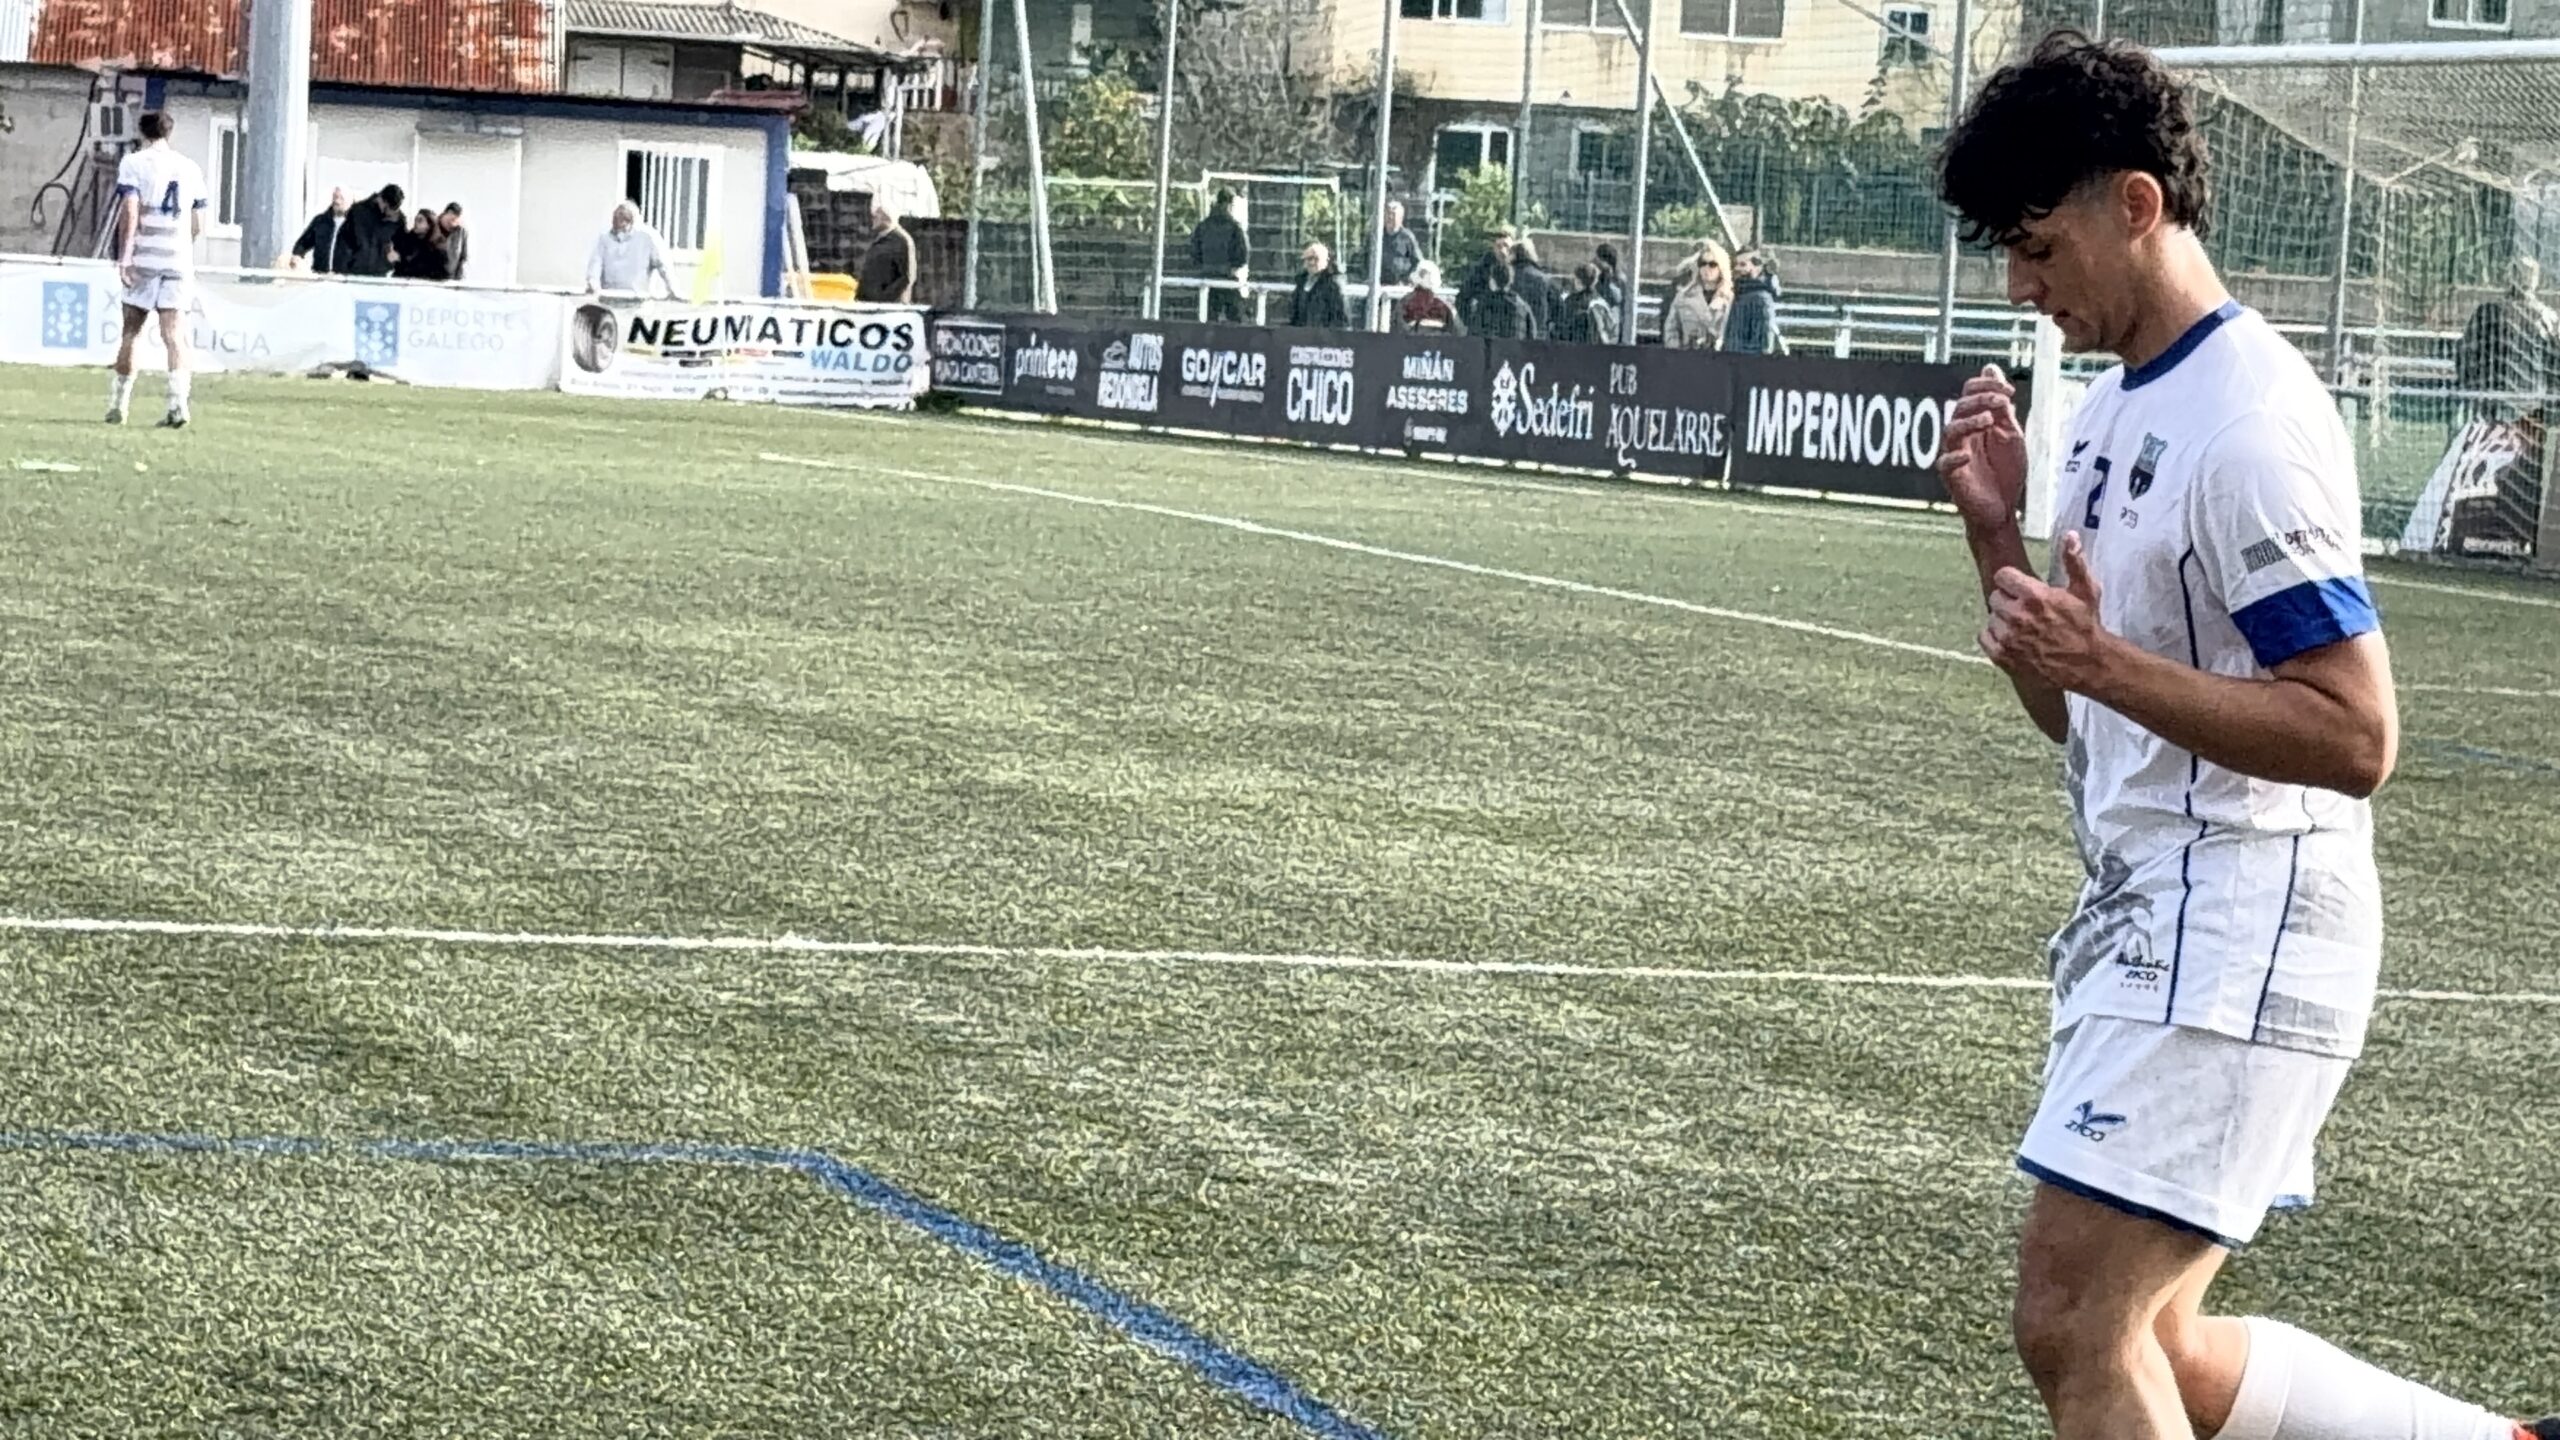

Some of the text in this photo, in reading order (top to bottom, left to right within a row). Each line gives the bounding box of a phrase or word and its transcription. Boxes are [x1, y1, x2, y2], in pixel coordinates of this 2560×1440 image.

[161, 181, 181, 219] 4
[409, 307, 513, 330] DEPORTE
[627, 315, 915, 353] NEUMATICOS
[408, 331, 504, 351] GALEGO
[1013, 332, 1078, 386] printeco
[810, 349, 914, 373] WALDO
[1609, 361, 1638, 396] PUB
[1287, 367, 1354, 426] CHICO
[1386, 385, 1468, 414] ASESORES
[1515, 362, 1595, 440] Sedefri
[1605, 403, 1727, 469] AQUELARRE
[2084, 456, 2112, 530] 2
